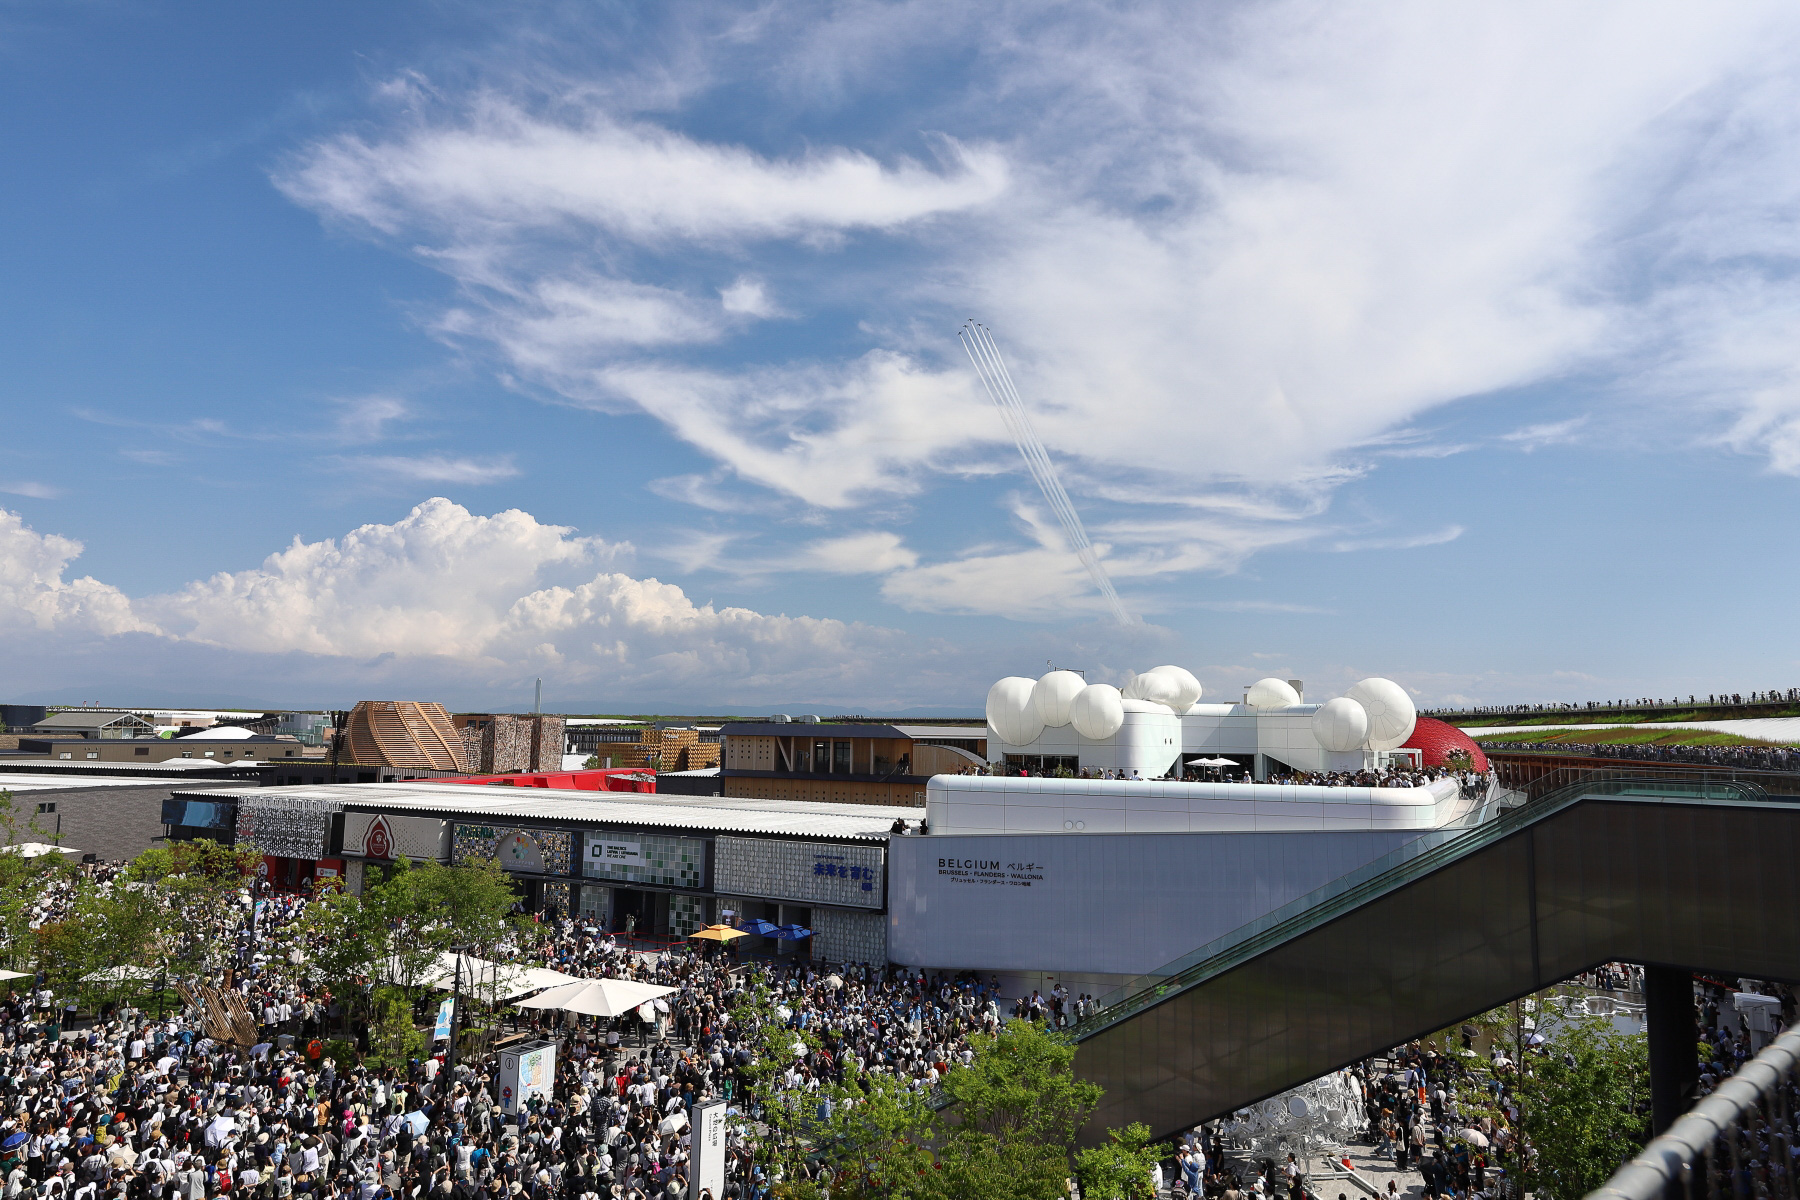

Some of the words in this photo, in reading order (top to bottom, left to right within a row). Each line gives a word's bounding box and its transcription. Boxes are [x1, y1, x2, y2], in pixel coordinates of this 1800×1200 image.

[813, 862, 874, 880] 未来を育む
[938, 858, 1000, 870] BELGIUM
[1007, 862, 1044, 872] ベルギー
